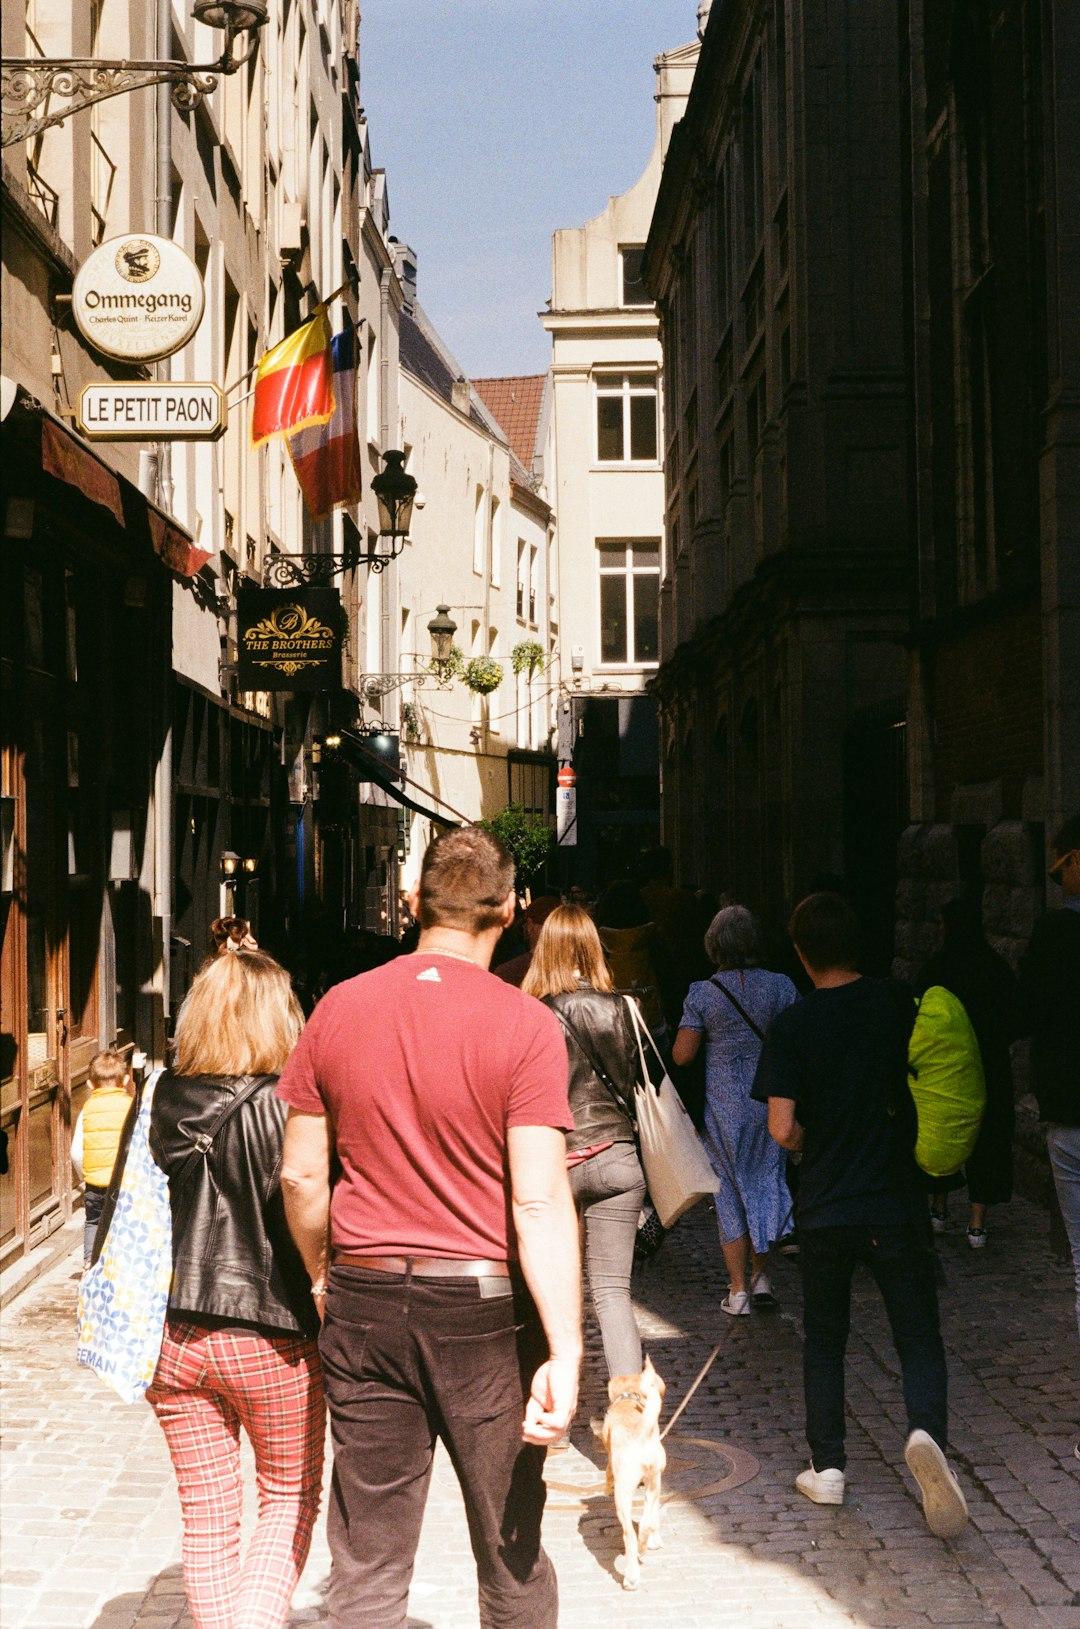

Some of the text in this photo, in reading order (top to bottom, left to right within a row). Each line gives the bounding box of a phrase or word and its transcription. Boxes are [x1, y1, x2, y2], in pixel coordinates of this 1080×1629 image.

[85, 290, 192, 313] Ommegang
[88, 397, 213, 422] LE PETIT PAON
[246, 640, 333, 650] THE BROTHERS
